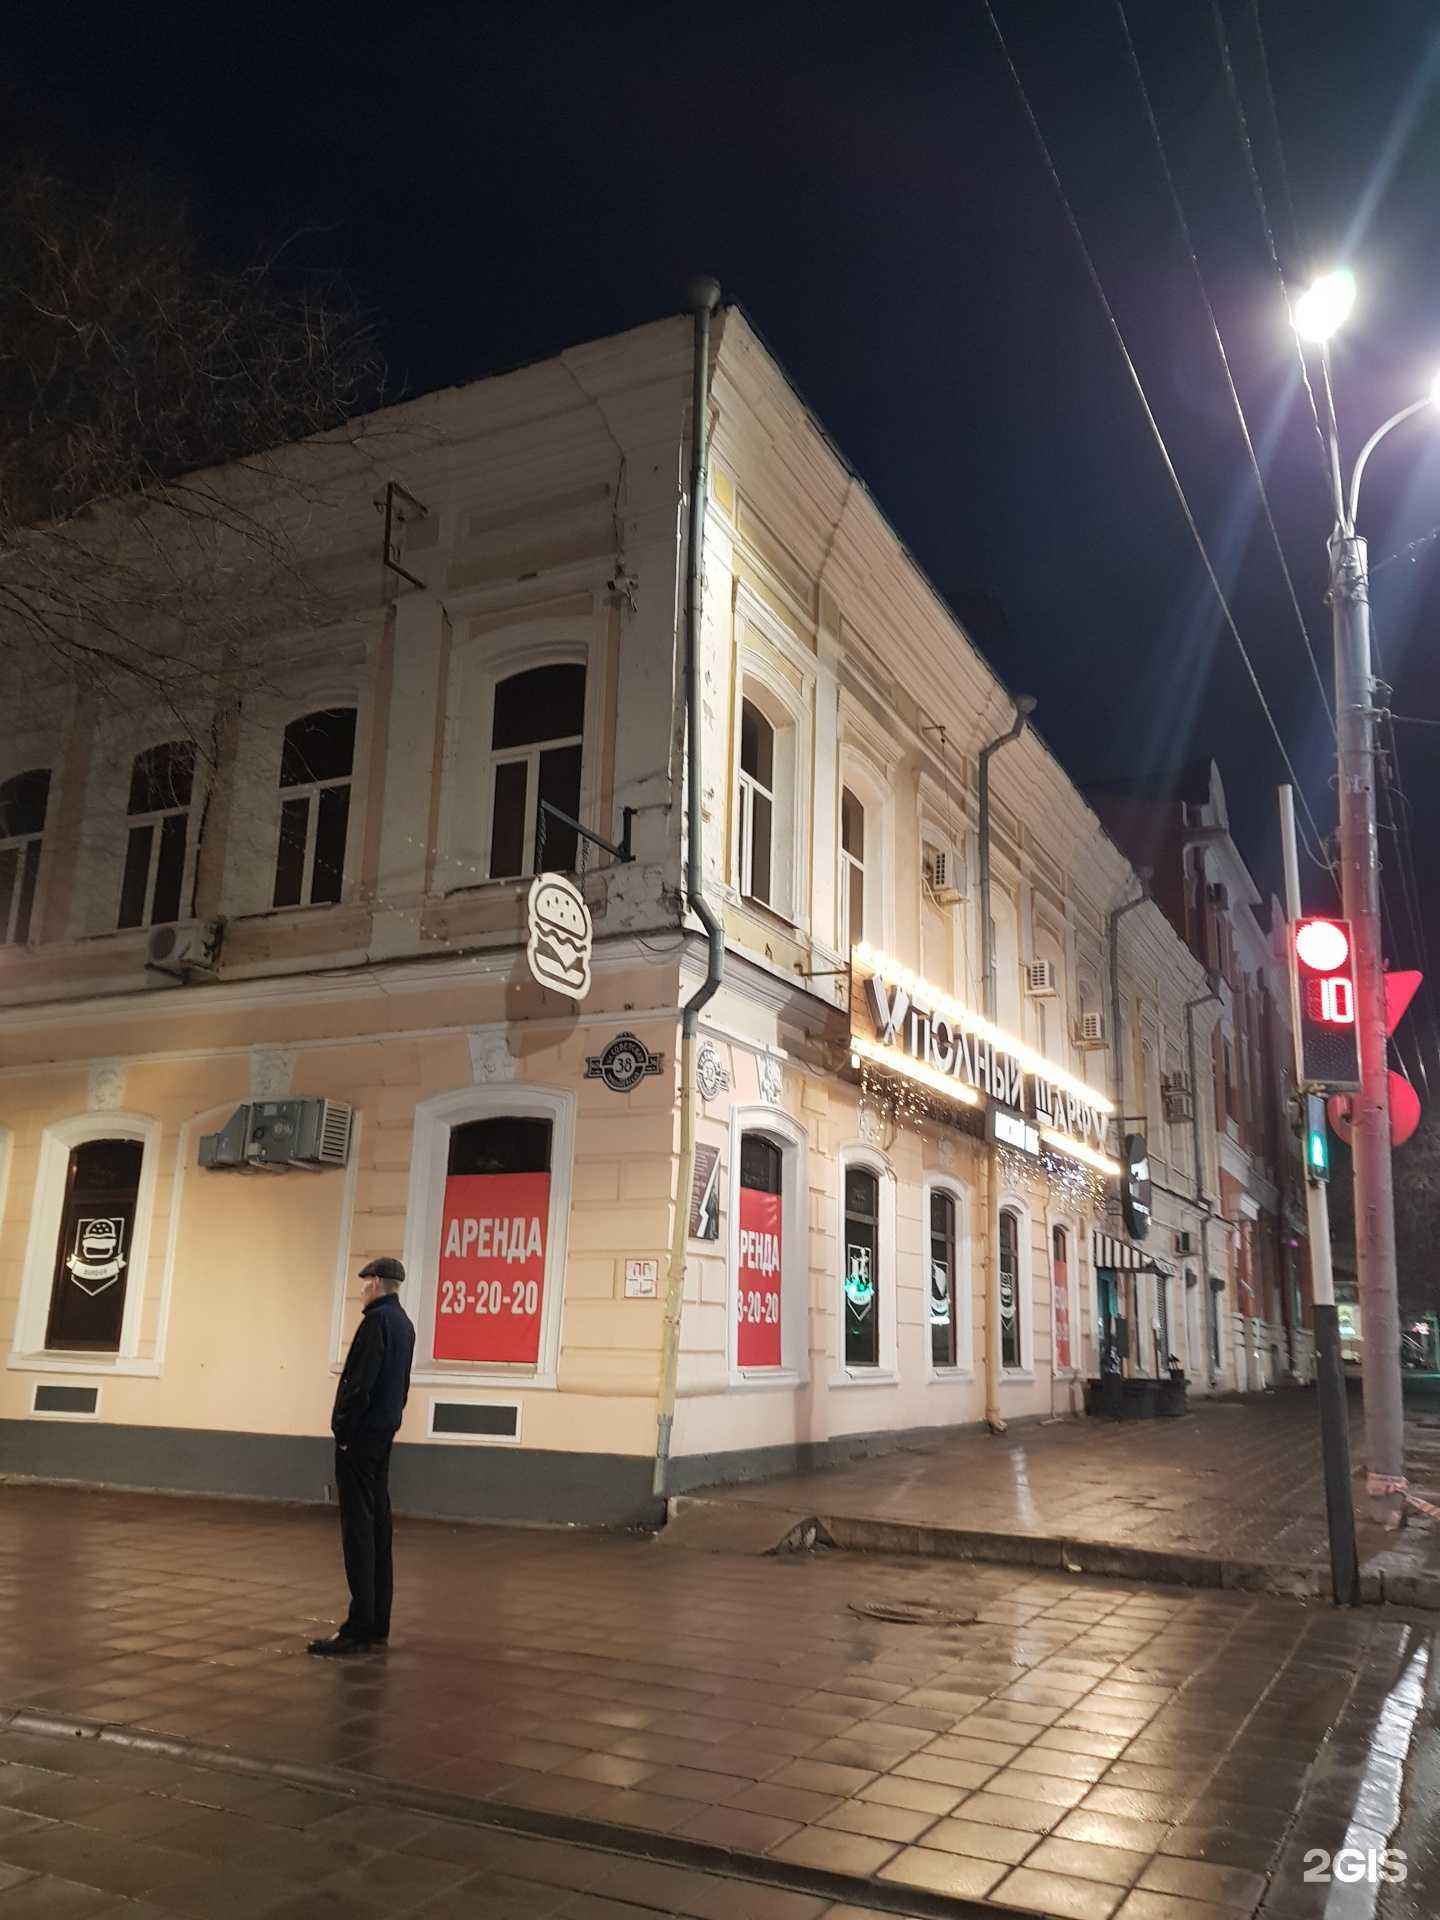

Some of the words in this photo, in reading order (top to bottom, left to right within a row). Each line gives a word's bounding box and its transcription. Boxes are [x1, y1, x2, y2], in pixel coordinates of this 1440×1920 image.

[1321, 977, 1354, 1023] 10
[444, 1217, 542, 1264] АРЕНДА
[440, 1280, 539, 1314] 23-20-20
